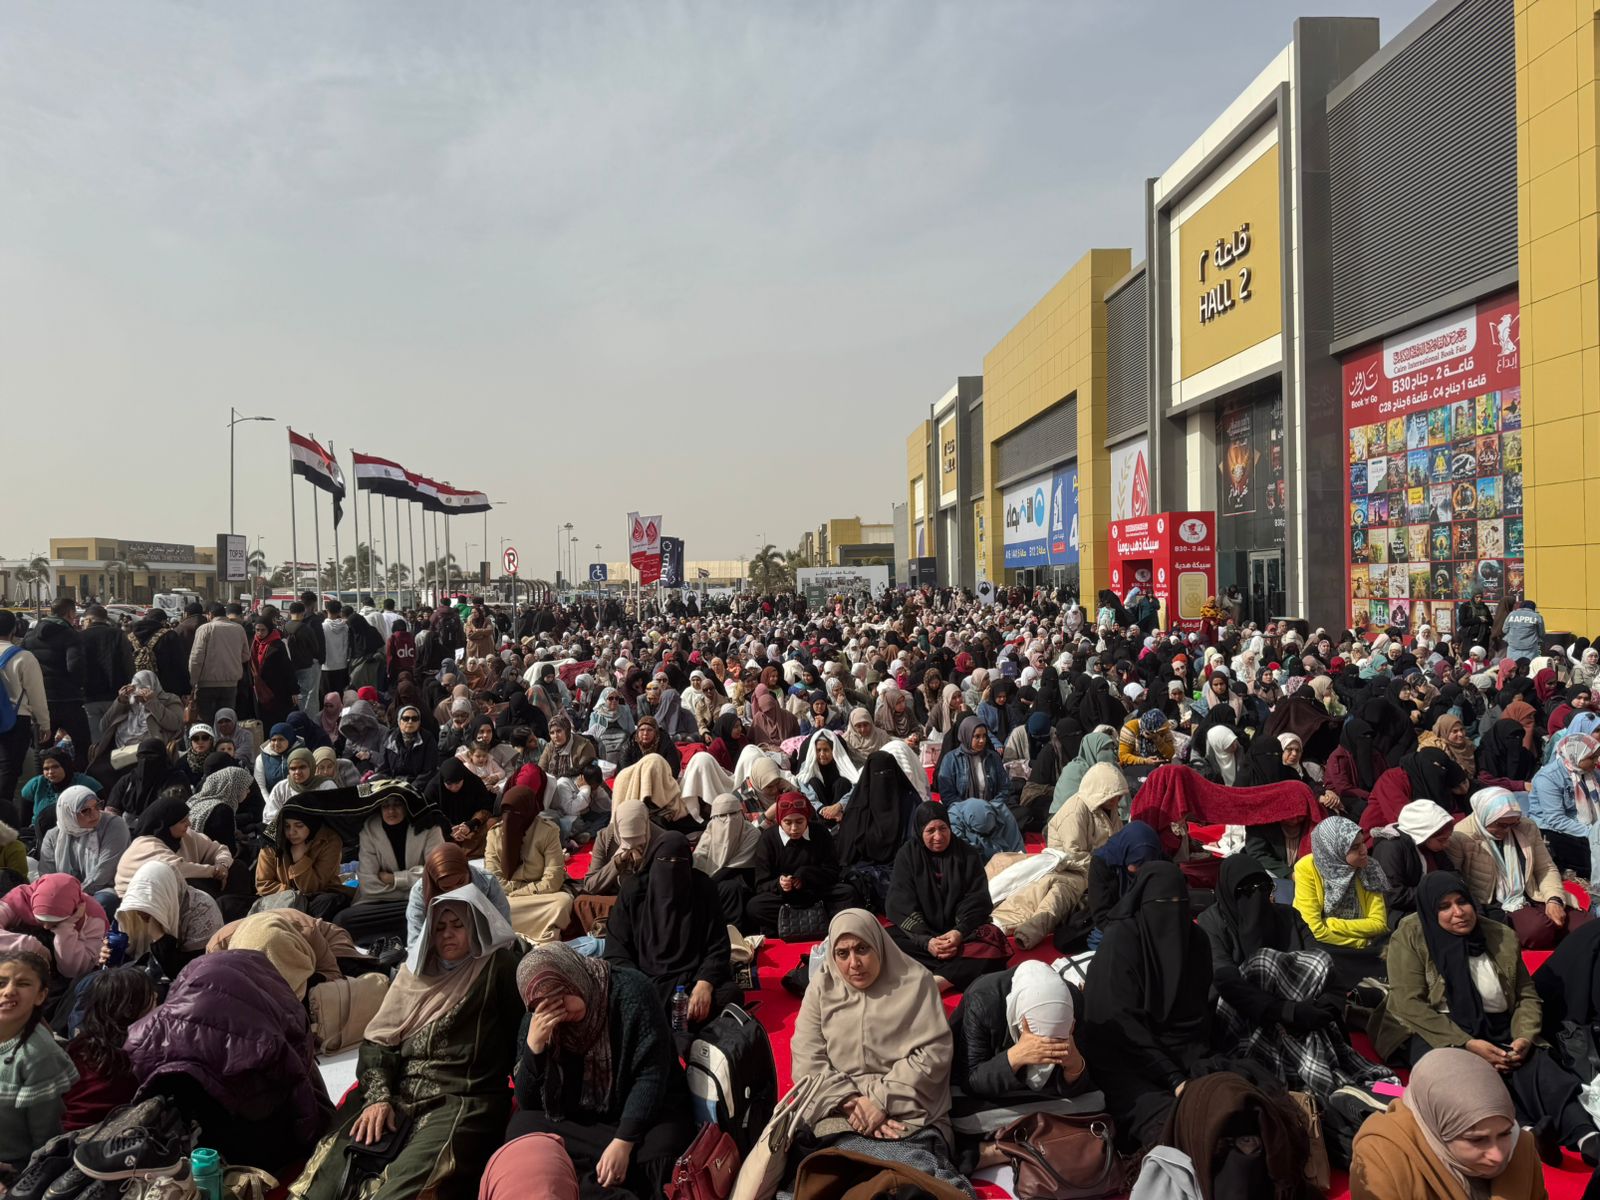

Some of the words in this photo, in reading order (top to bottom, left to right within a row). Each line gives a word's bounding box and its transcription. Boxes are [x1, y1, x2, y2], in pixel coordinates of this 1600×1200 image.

[1214, 222, 1250, 269] قاعة
[1199, 278, 1235, 324] HALL
[1239, 267, 1252, 301] 2
[1393, 364, 1407, 375] Cairo
[1407, 352, 1440, 369] International
[1440, 348, 1455, 359] Book
[1455, 344, 1467, 354] Fair
[1435, 367, 1443, 379] 2
[1467, 373, 1487, 388] قاعة
[1392, 376, 1411, 395] B30
[1411, 372, 1429, 391] جناح
[1370, 394, 1378, 404] Go
[1411, 391, 1428, 404] قاعة
[1433, 386, 1444, 398] C4
[1378, 401, 1392, 413] C28
